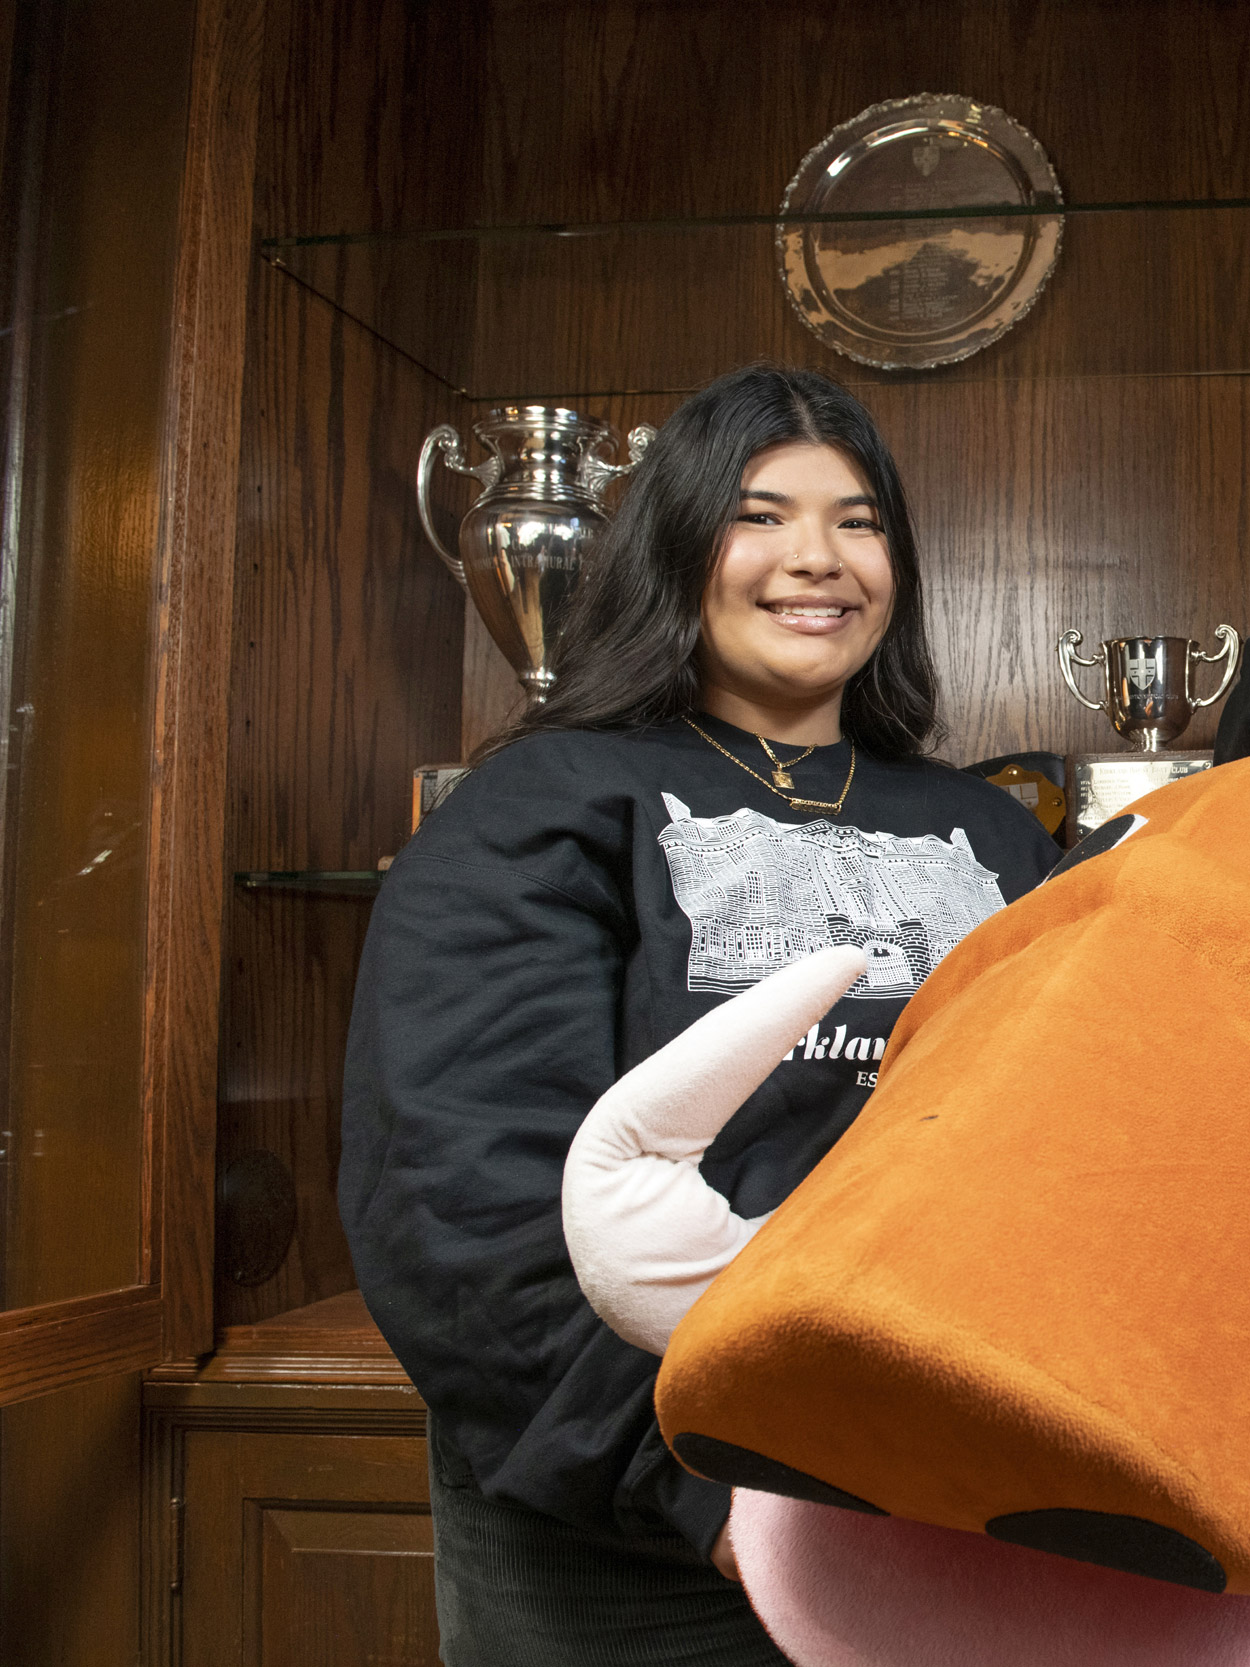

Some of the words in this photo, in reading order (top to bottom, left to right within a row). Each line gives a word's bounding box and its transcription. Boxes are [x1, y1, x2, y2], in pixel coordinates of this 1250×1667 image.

[1171, 765, 1189, 774] CLUB
[782, 1023, 890, 1061] rklan
[856, 1071, 879, 1088] ES
